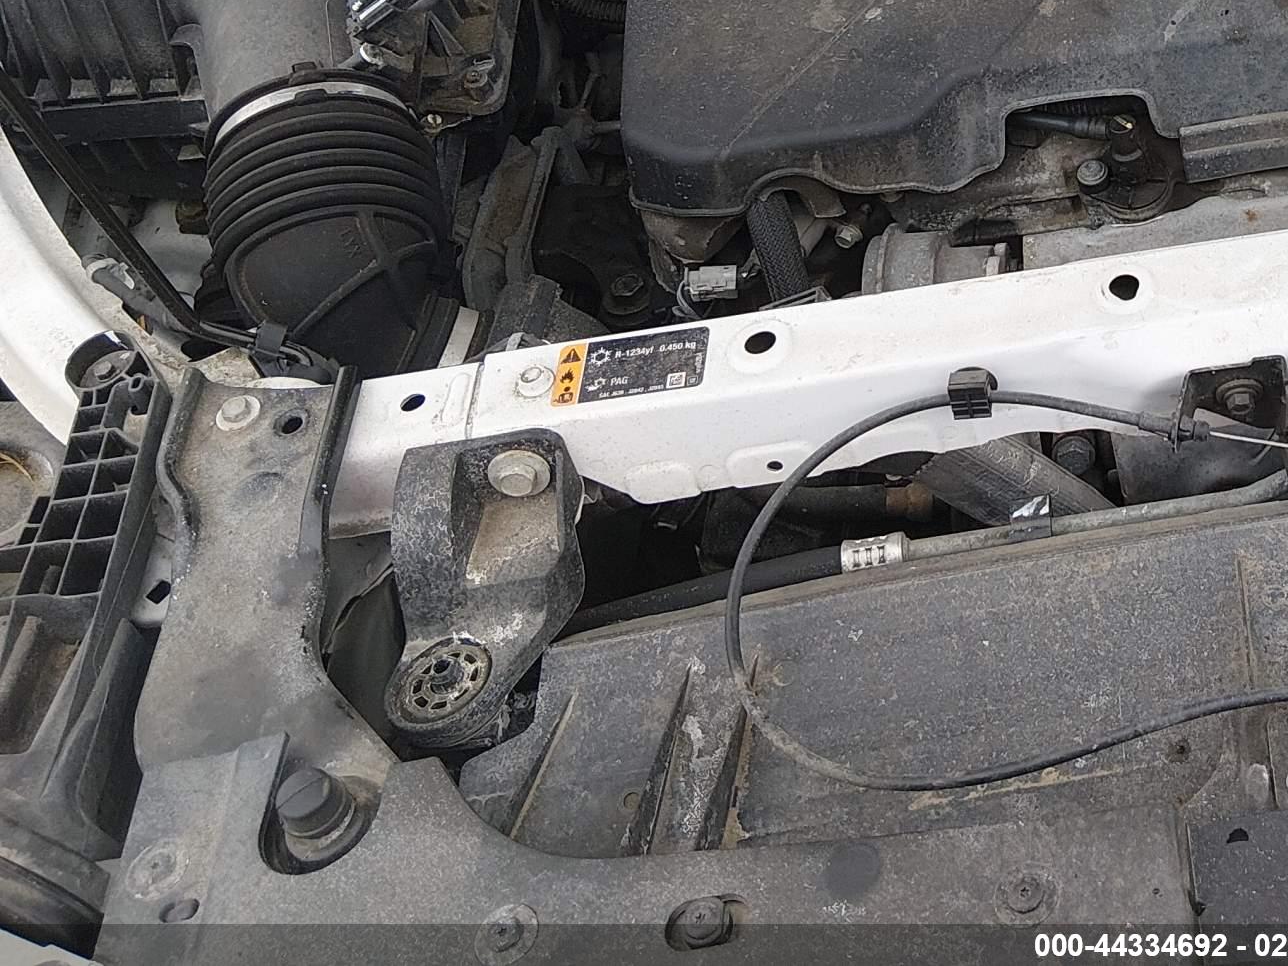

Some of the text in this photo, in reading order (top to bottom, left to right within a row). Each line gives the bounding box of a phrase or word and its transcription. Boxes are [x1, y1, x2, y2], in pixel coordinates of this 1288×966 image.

[614, 340, 697, 358] R-1234yf 0.450 kg
[610, 376, 630, 386] PAG
